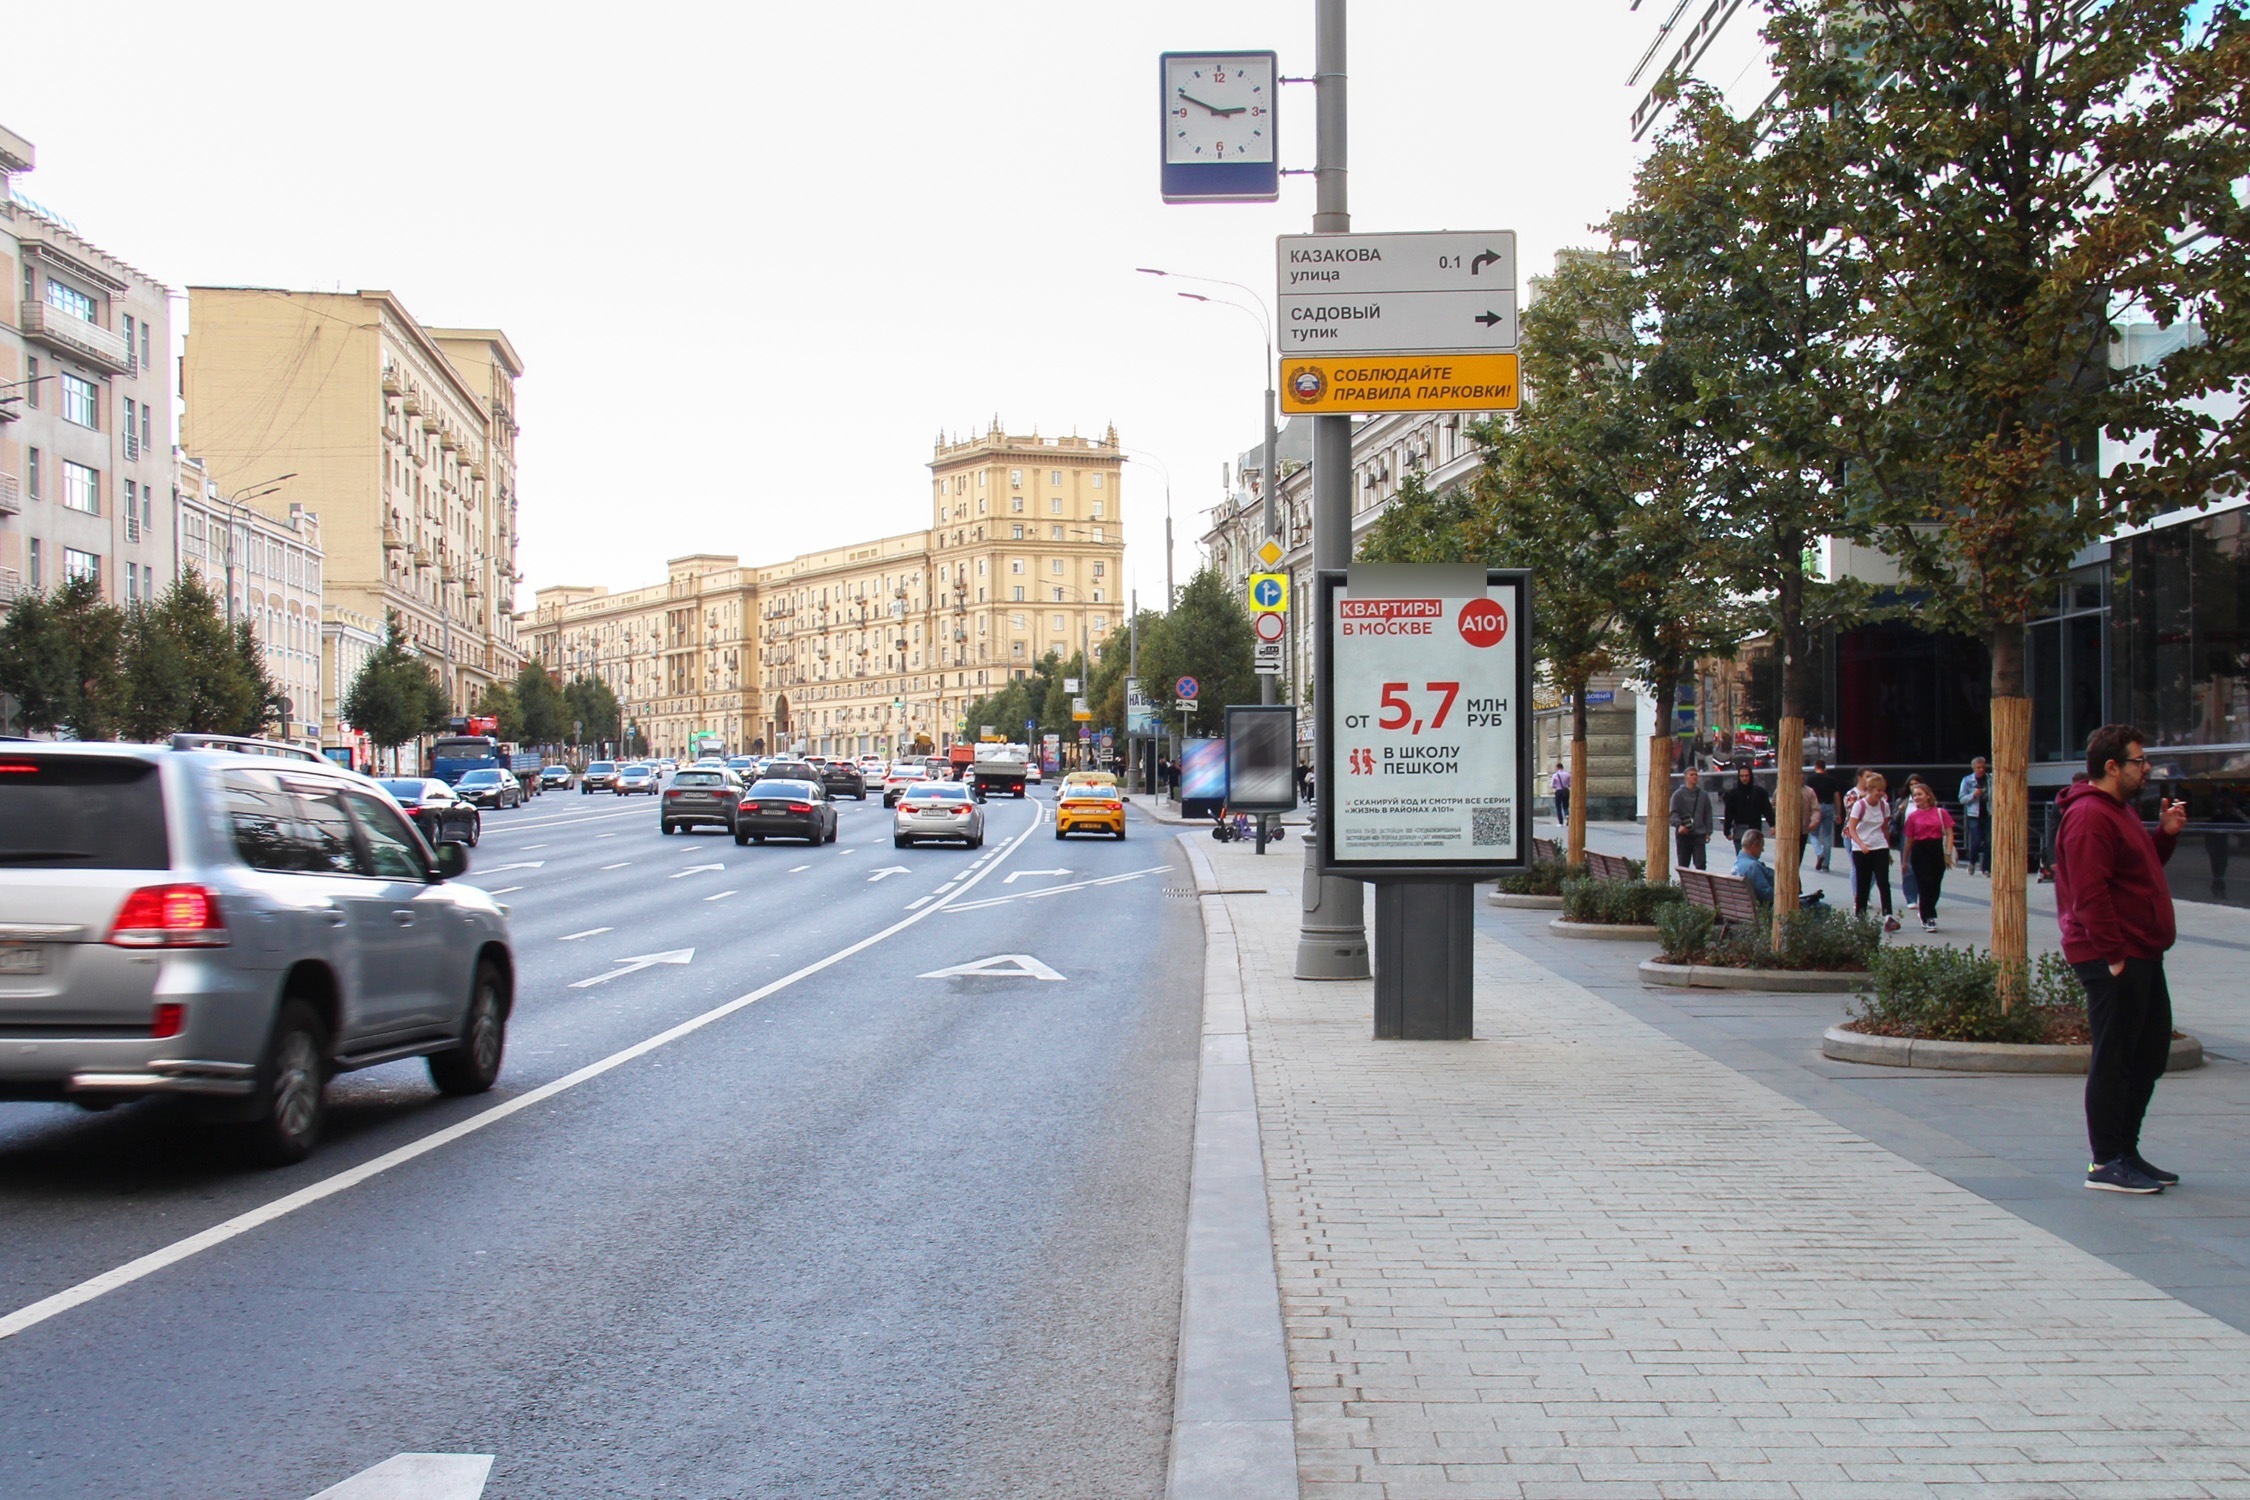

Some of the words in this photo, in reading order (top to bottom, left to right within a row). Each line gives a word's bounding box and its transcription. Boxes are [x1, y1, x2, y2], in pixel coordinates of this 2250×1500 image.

[1213, 73, 1225, 83] 12
[1180, 107, 1188, 118] 9
[1251, 106, 1260, 116] 3
[1216, 141, 1224, 152] 6
[1290, 248, 1382, 263] КАЗАКОВА
[1439, 256, 1461, 269] 0.1
[1290, 270, 1340, 285] улица
[1291, 303, 1381, 322] САДОВЫЙ
[1291, 328, 1338, 342] тупик
[1333, 366, 1453, 383] СОБЛЮДАЙТЕ
[1333, 387, 1412, 401] ПРАВИЛА
[1416, 384, 1511, 399] ПАРКОВКИ!
[1342, 602, 1440, 617] КВАРТИРЫ
[1343, 622, 1354, 636] В
[1359, 621, 1433, 636] МОСКВЕ
[1461, 614, 1505, 632] А101
[1345, 715, 1370, 729] ОТ
[1379, 682, 1460, 735] 5,7
[1467, 698, 1507, 712] МЛН
[1467, 713, 1502, 727] РУБ
[1384, 747, 1394, 759] В
[1400, 747, 1460, 759] ШКОЛУ
[1384, 762, 1458, 775] ПЕШКОМ
[1354, 798, 1399, 806] СКАНИРУЙ
[1401, 798, 1419, 806] КОД
[1465, 797, 1481, 805] ВСЕ
[1345, 806, 1381, 814] «ЖИЗНЬ
[1390, 805, 1429, 813] РАЙОНАХ
